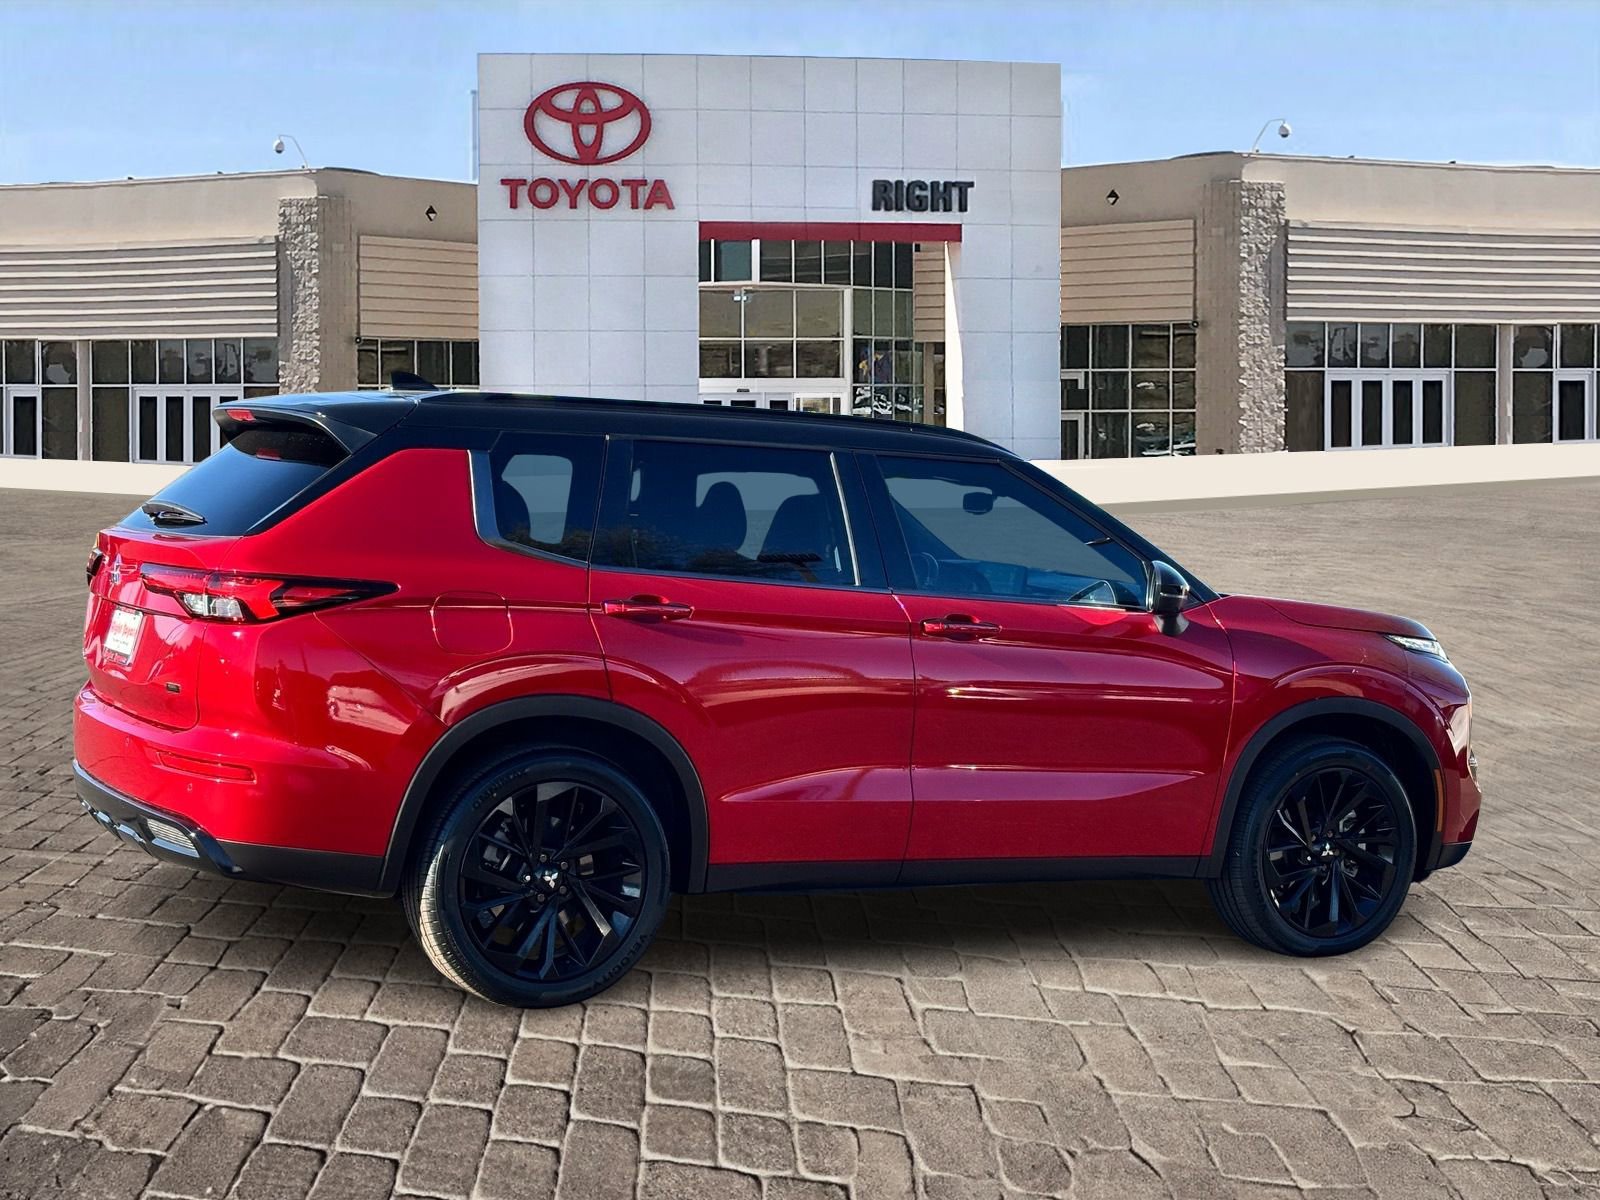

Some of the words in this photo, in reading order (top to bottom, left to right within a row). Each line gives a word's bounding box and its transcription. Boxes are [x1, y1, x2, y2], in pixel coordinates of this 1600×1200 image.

[500, 178, 675, 210] TOYOTA
[871, 179, 975, 212] RIGHT
[594, 935, 647, 988] VELOCITY
